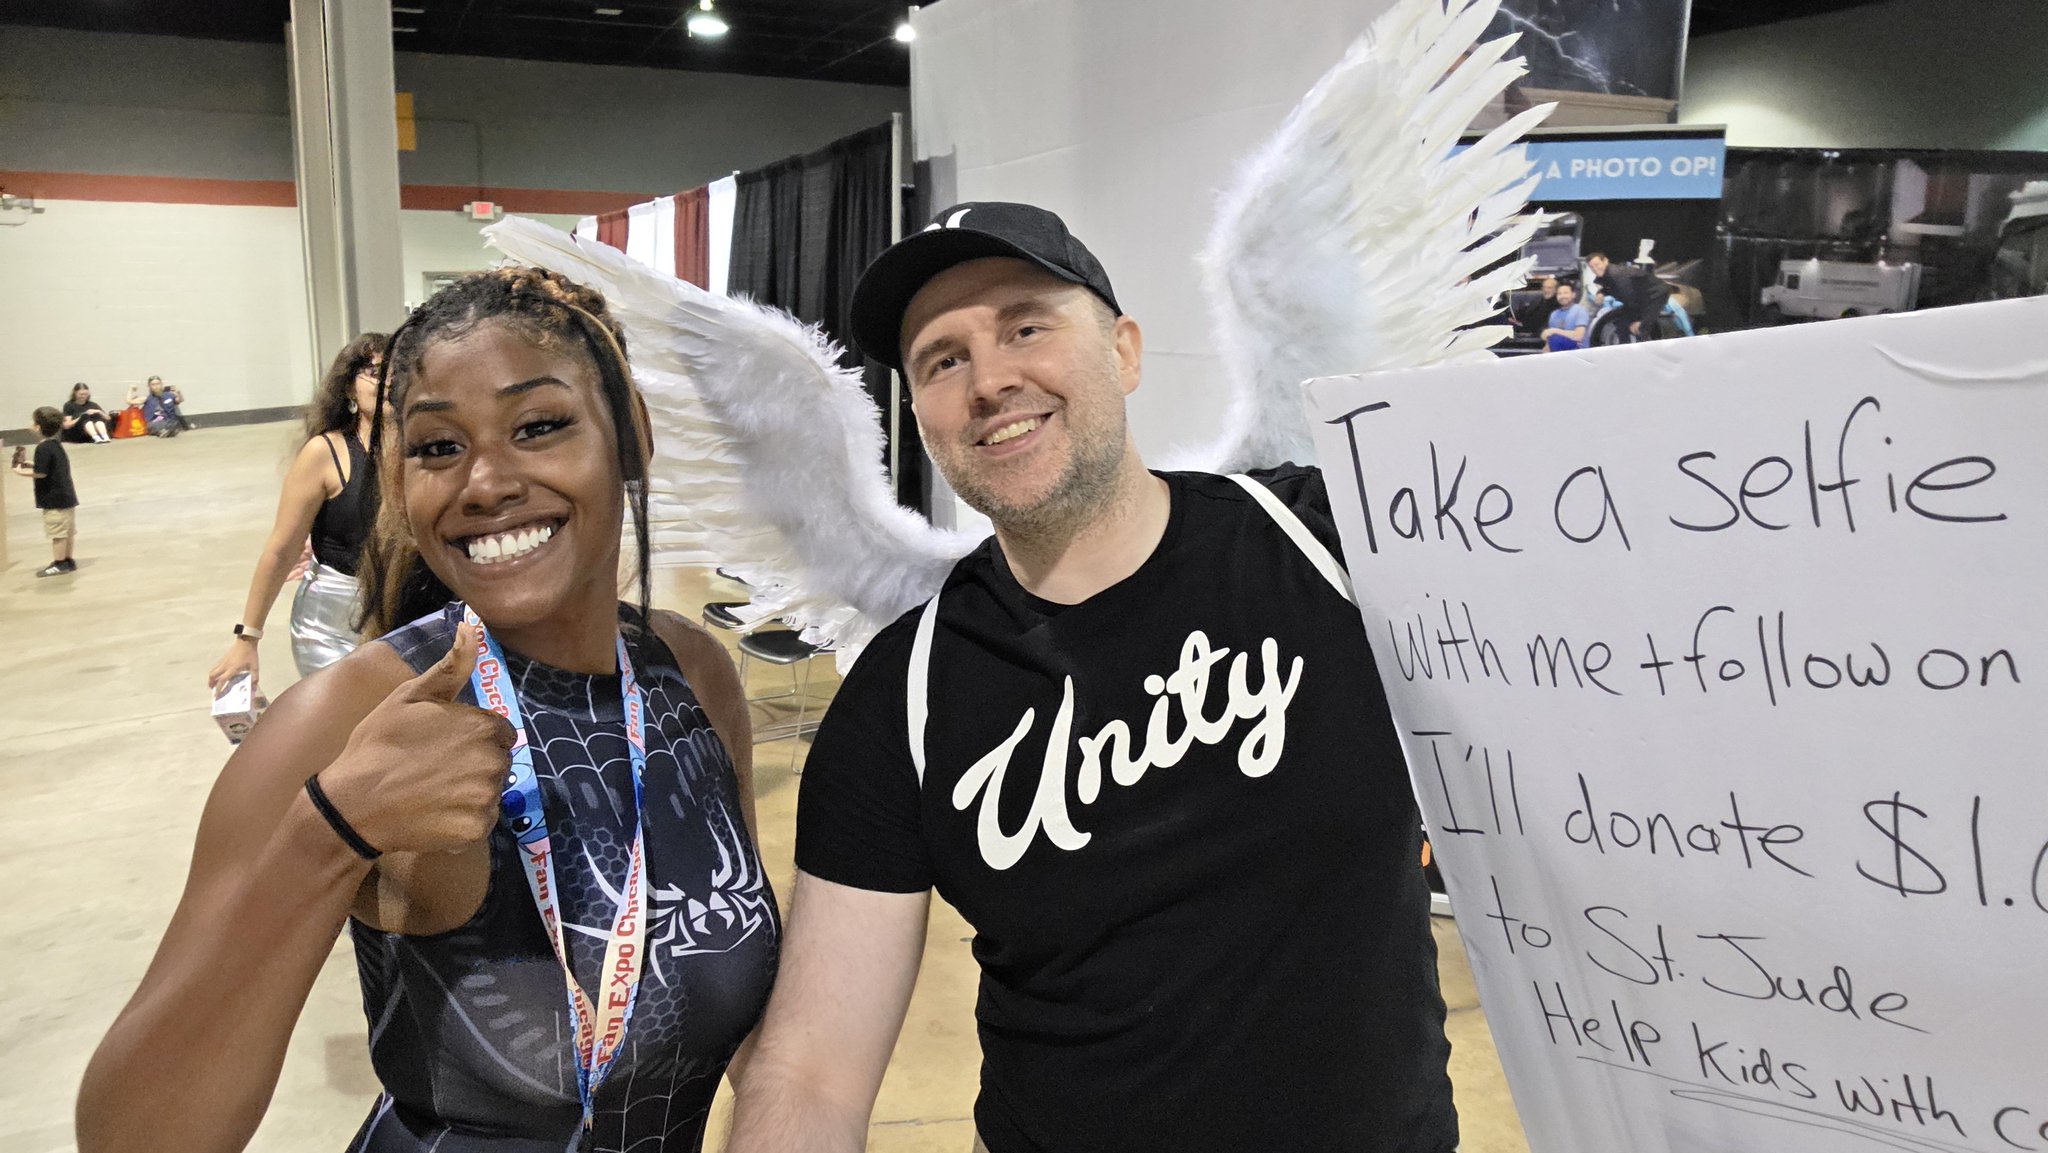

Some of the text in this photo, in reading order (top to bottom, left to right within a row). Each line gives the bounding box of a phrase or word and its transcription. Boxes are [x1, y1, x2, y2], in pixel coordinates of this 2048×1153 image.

[1546, 160, 1563, 179] A
[1570, 156, 1662, 178] PHOTO
[1670, 156, 1716, 177] OP!
[1326, 395, 2009, 555] Take a selfie
[479, 658, 510, 718] Chica
[1526, 632, 1623, 697] me
[1916, 648, 2022, 691] on
[952, 630, 1304, 871] Unity
[1411, 730, 1524, 837] I'll
[1564, 771, 1816, 879] donate
[530, 850, 549, 901] Fan
[573, 977, 594, 1068] hicago
[596, 840, 642, 1066] Fan Expo Chicago
[1486, 874, 1932, 1036] to St. Jude
[1532, 979, 1662, 1068] Help
